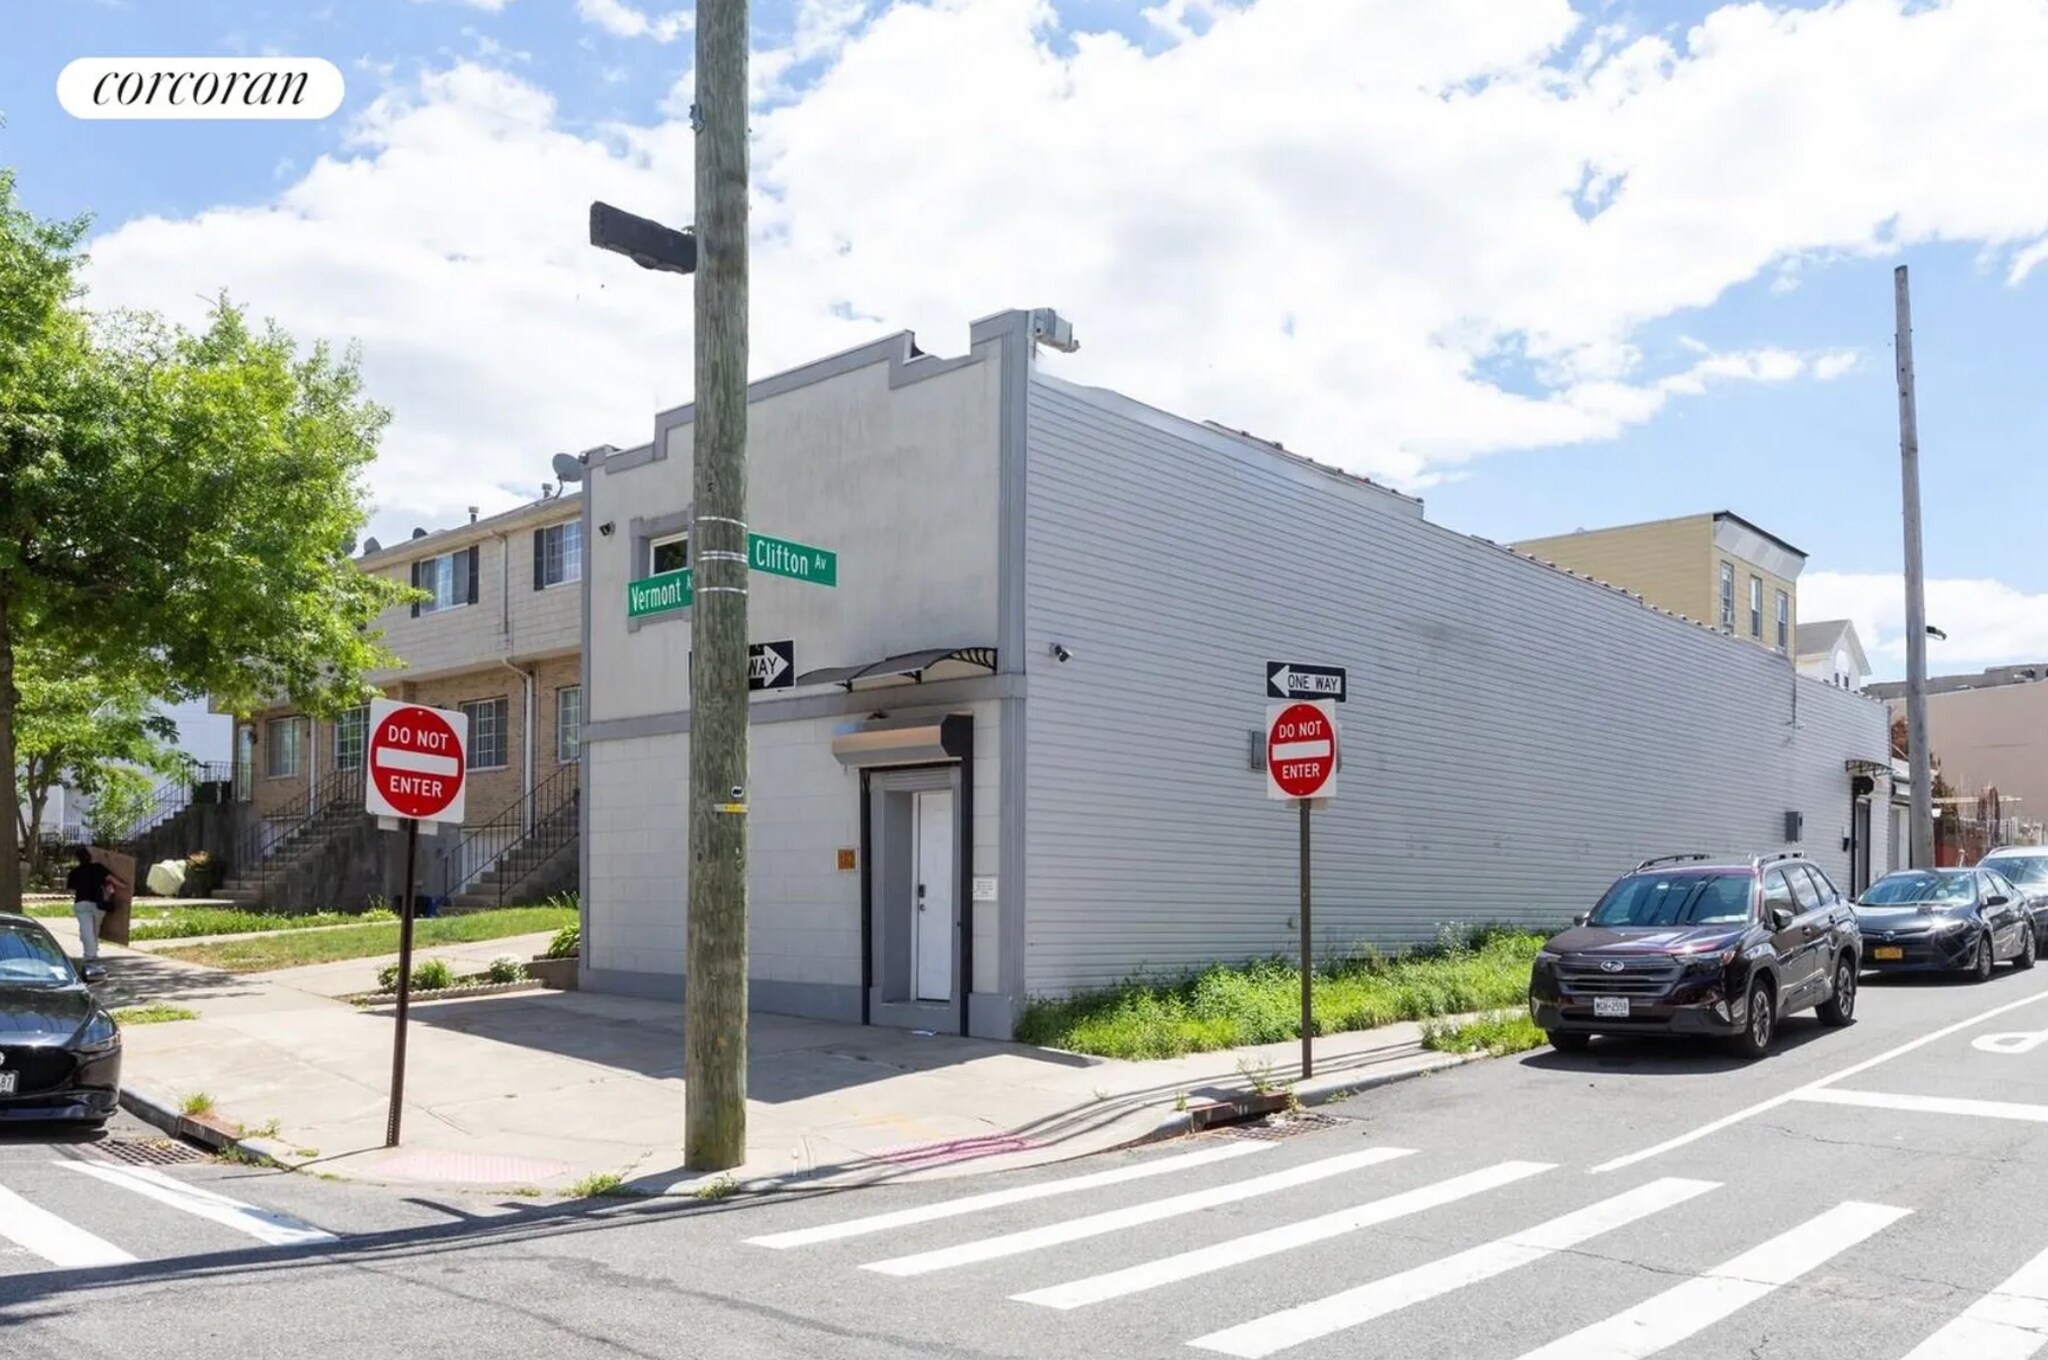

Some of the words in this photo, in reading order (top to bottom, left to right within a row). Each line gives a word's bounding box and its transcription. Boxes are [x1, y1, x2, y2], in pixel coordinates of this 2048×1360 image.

[756, 539, 808, 576] Clifton
[814, 553, 827, 571] Av
[631, 577, 682, 612] Vermont
[1287, 674, 1310, 689] ONE
[1315, 676, 1339, 692] WAY
[387, 725, 411, 744] DO
[416, 729, 449, 750] NOT
[1278, 723, 1295, 738] DO
[1299, 720, 1323, 737] NOT
[1282, 763, 1320, 780] ENTER
[389, 775, 443, 798] ENTER
